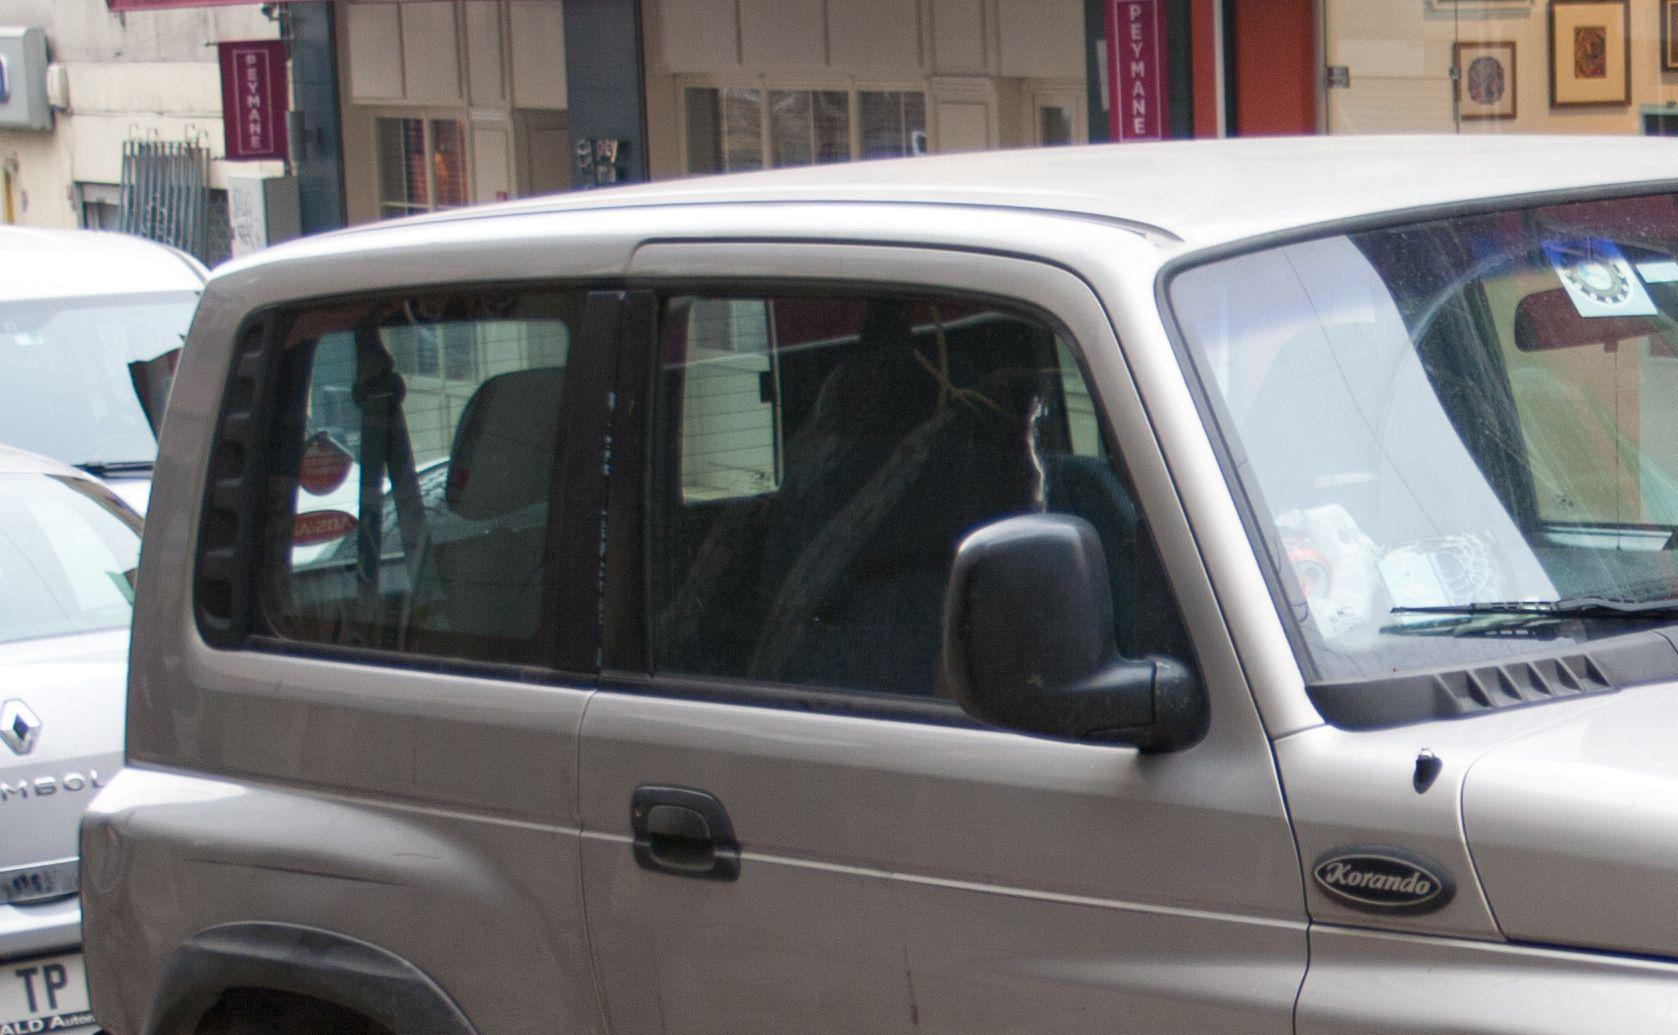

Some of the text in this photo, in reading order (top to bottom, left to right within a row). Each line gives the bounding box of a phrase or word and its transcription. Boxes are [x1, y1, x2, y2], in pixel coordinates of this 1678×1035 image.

[245, 54, 262, 149] PEYMANE
[1129, 4, 1145, 134] PEYMANE
[1327, 863, 1430, 895] Korando
[15, 962, 68, 1013] TP
